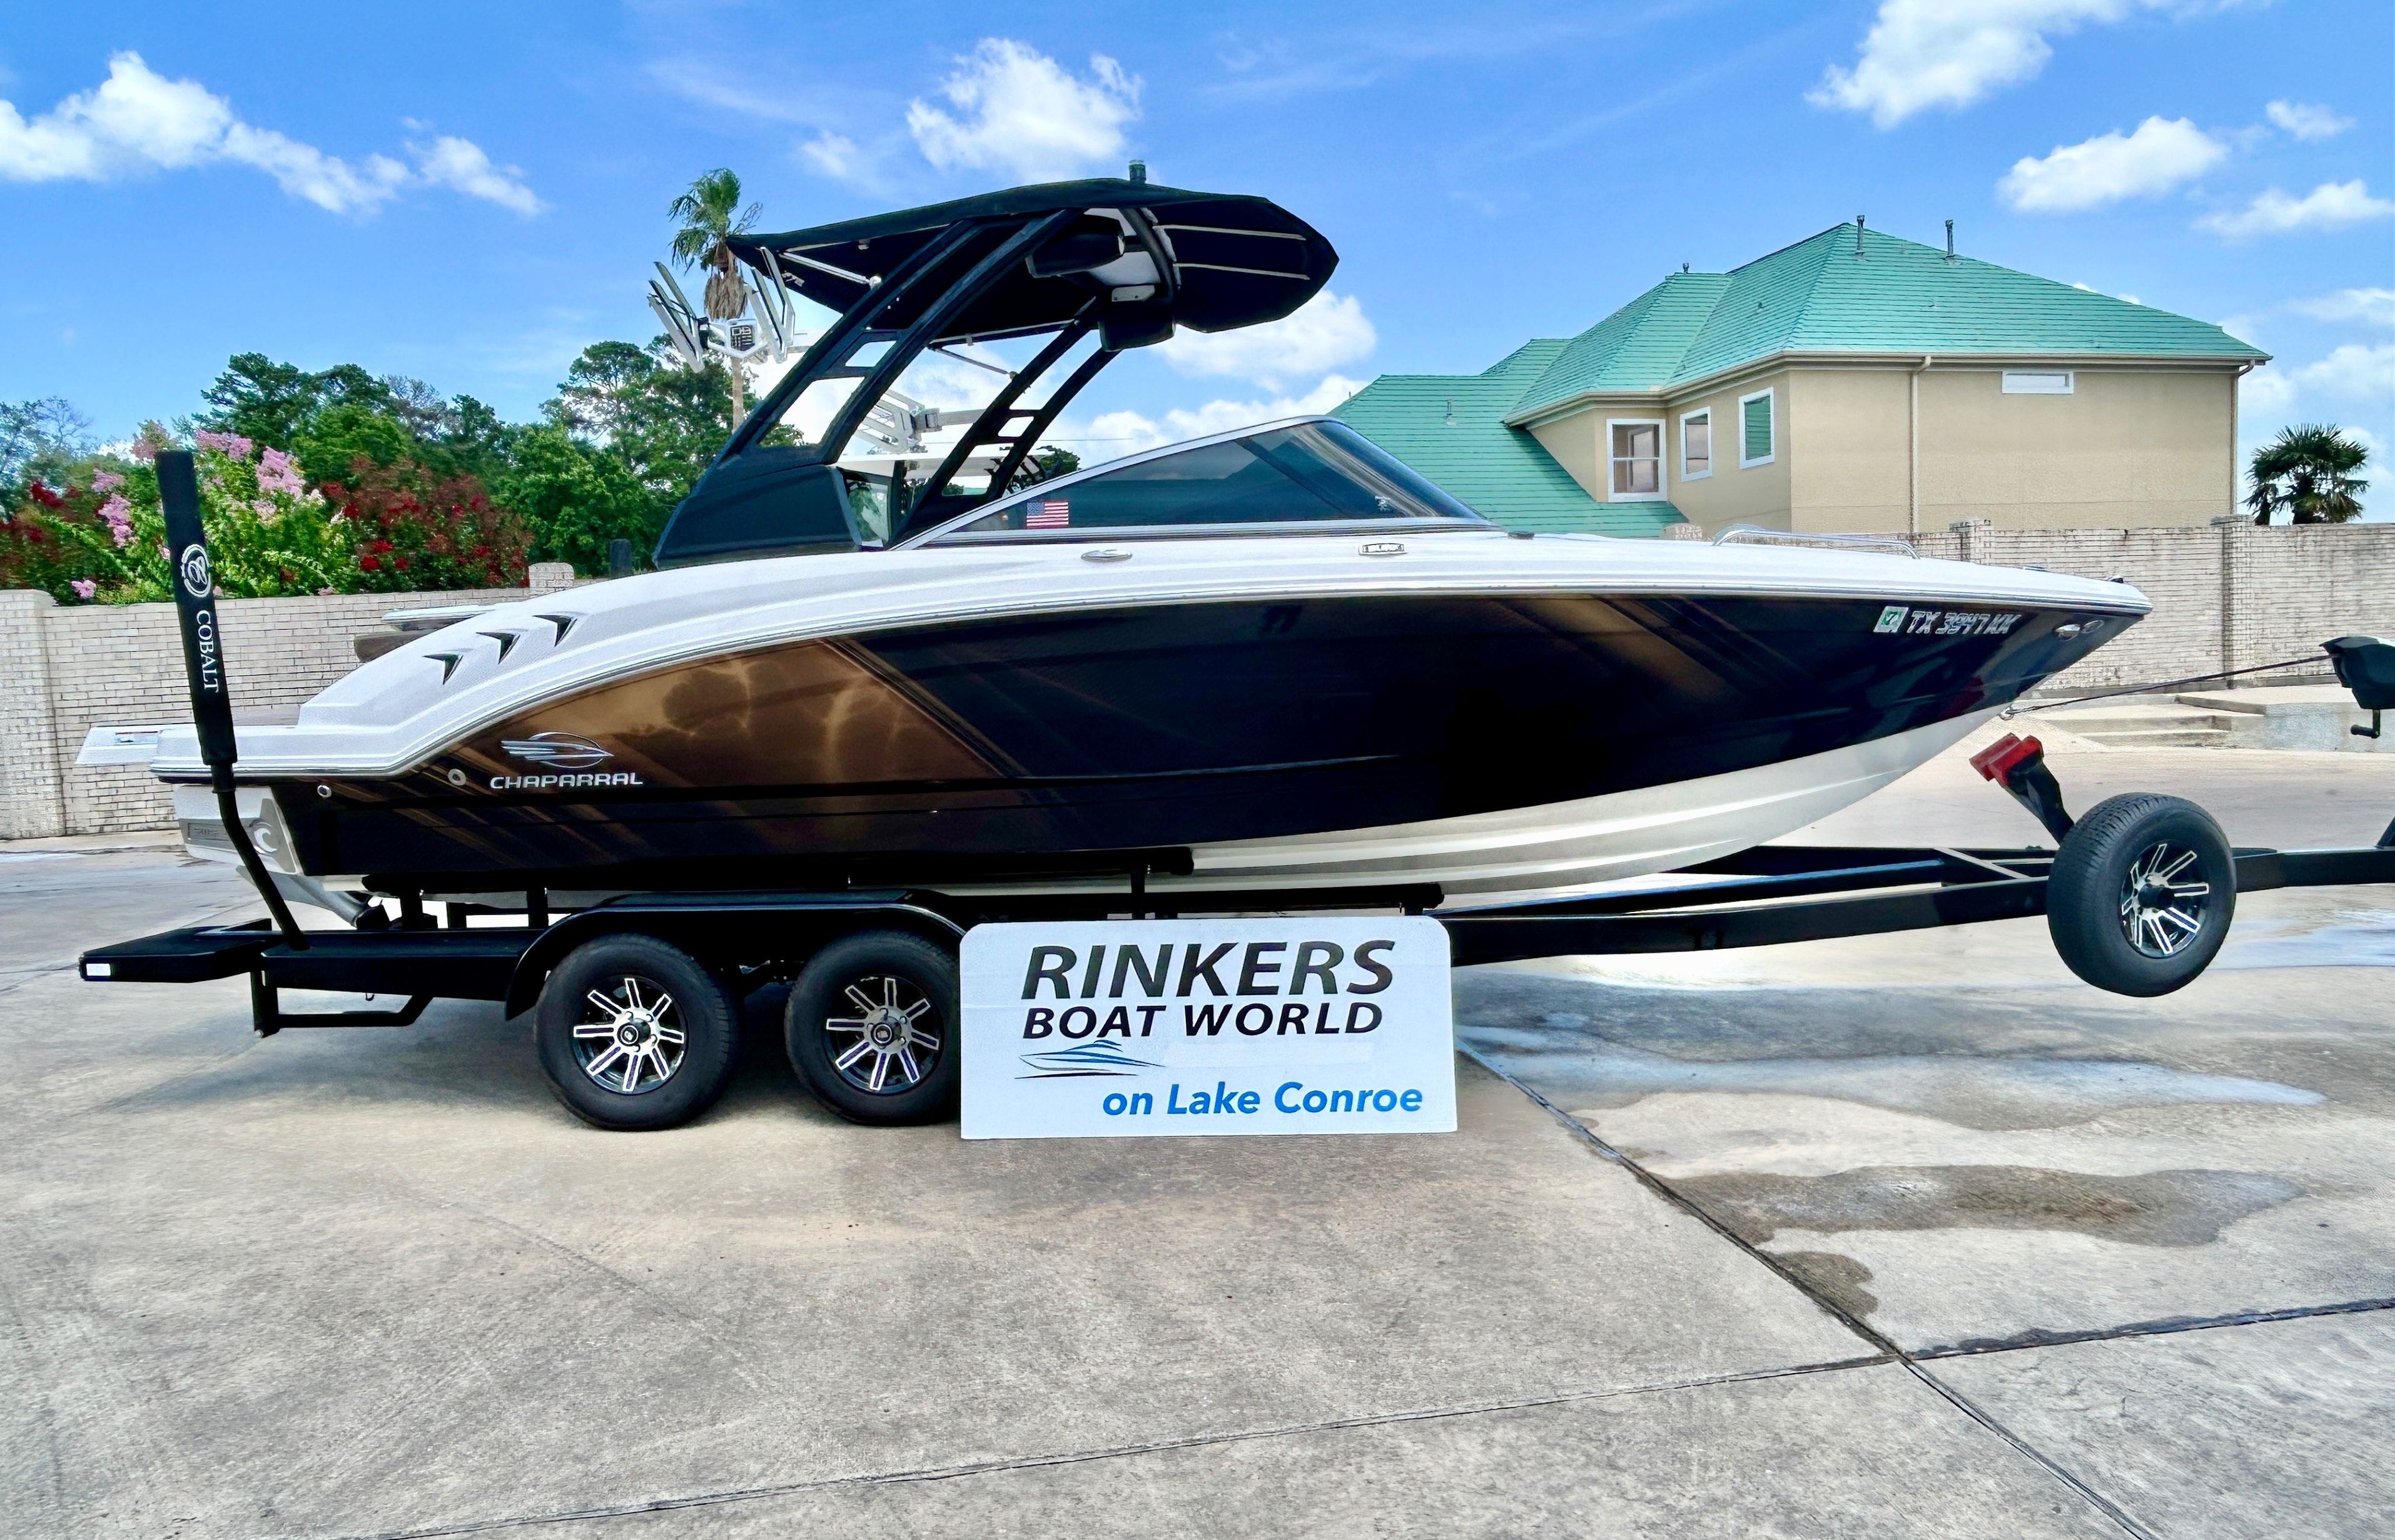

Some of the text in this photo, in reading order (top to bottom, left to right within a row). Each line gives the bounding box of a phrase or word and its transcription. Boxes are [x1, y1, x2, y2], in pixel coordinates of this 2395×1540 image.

[1906, 610, 1941, 634] TX
[196, 609, 220, 693] COBALT
[490, 772, 644, 789] CHAPARRAL
[1021, 940, 1395, 1000] RINKERS
[1023, 1001, 1383, 1039] BOAT WORLD
[1102, 1081, 1424, 1117] on Lake Conroe
